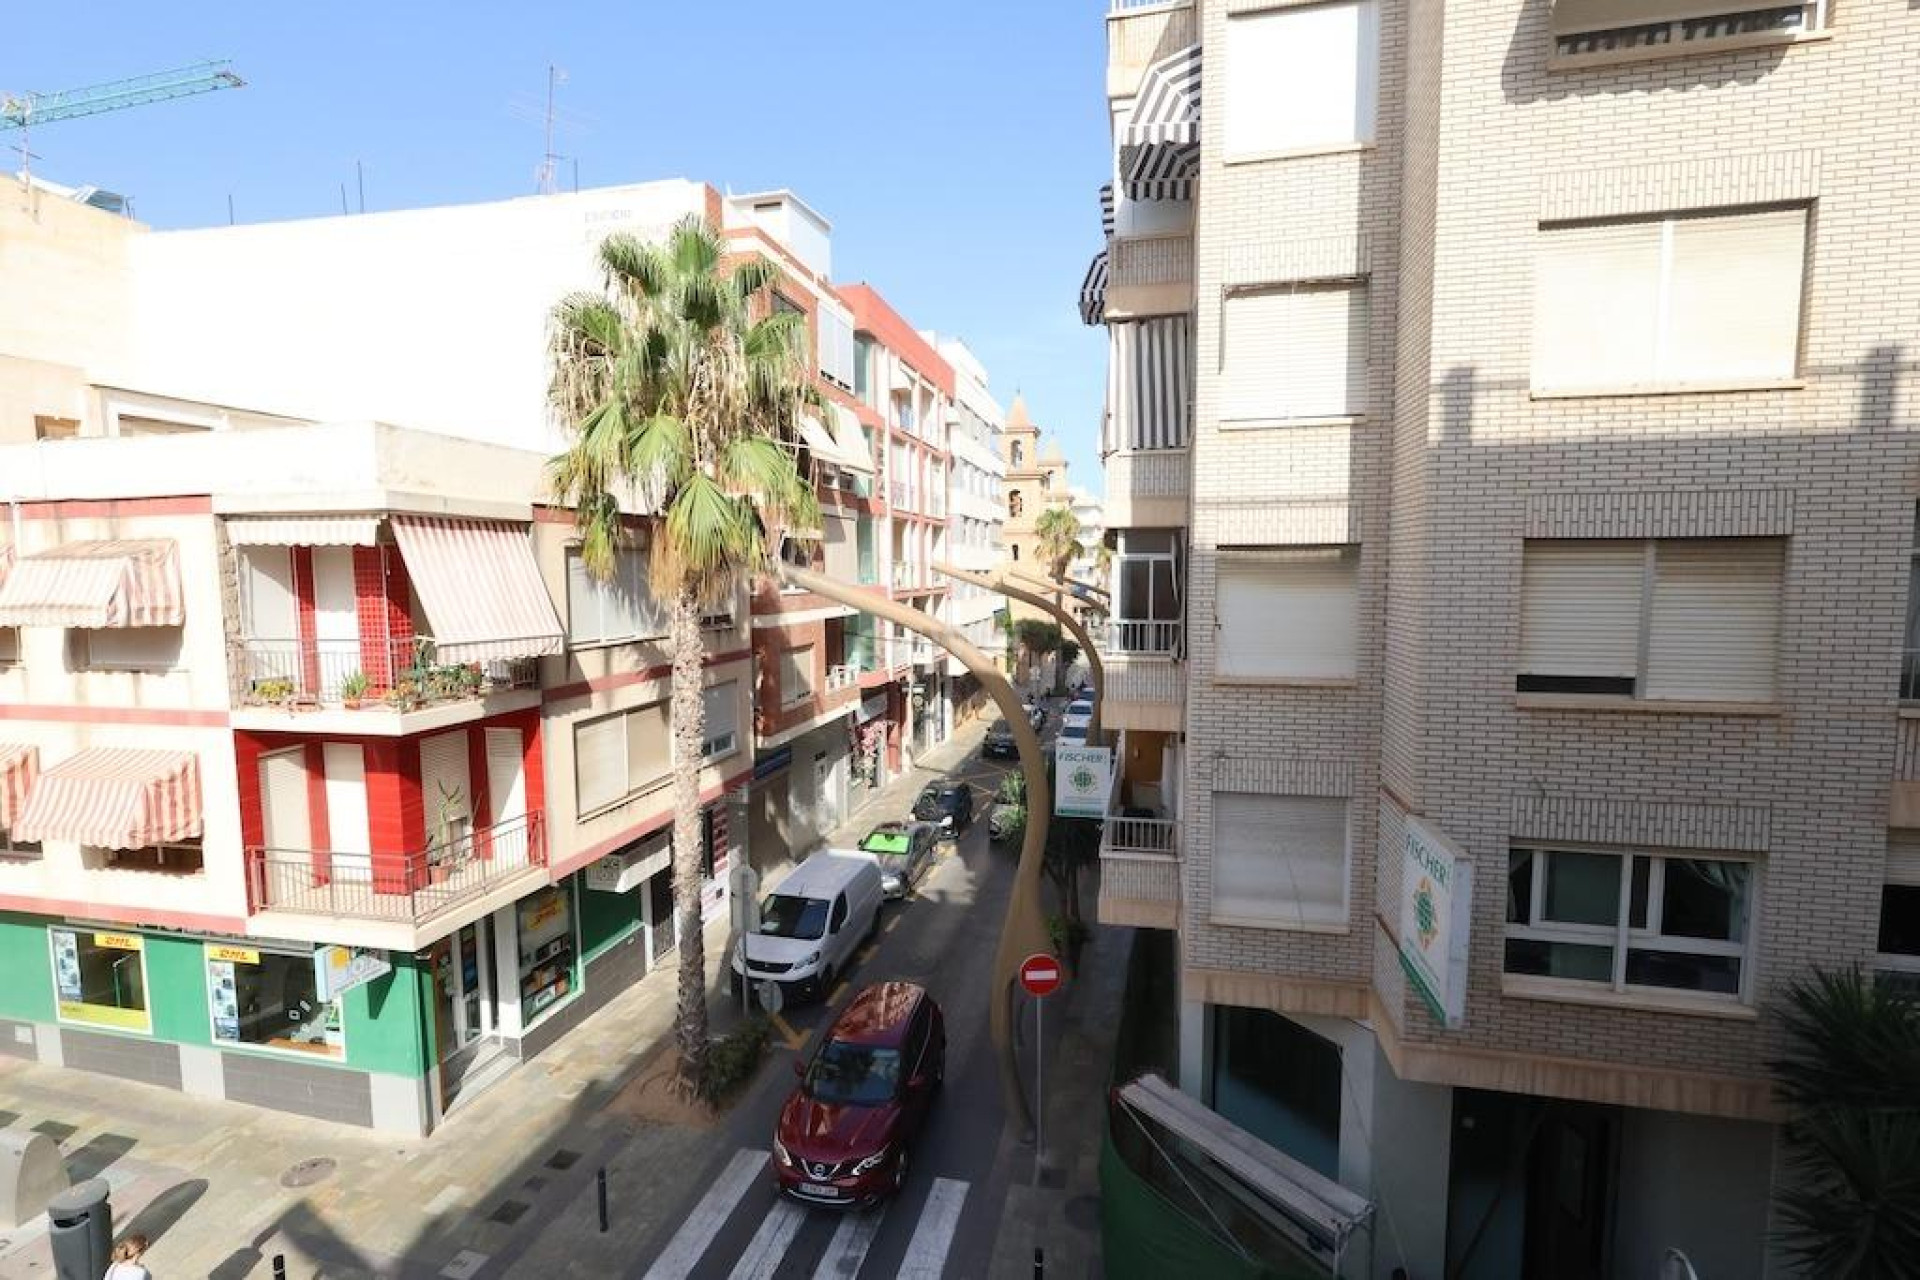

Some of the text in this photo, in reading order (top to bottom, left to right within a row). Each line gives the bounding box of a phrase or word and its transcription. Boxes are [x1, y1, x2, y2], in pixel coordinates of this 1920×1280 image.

[1406, 834, 1446, 888] FISCHER
[104, 935, 133, 947] DHL
[219, 949, 248, 961] DHL
